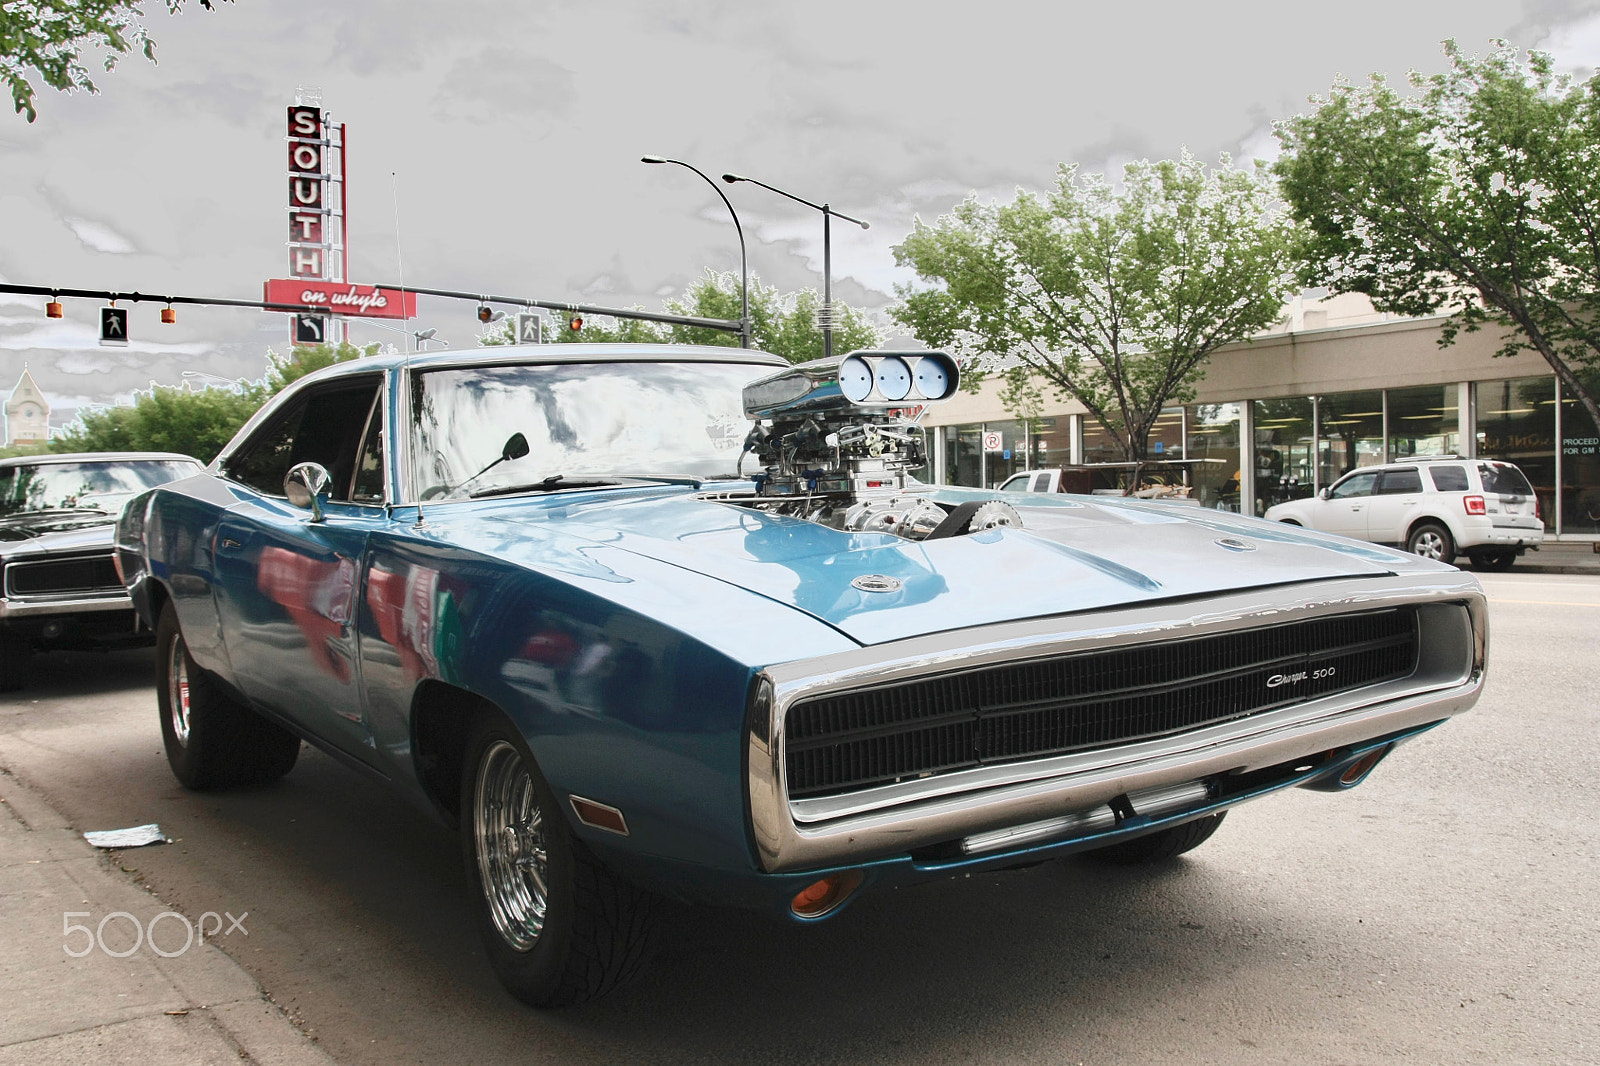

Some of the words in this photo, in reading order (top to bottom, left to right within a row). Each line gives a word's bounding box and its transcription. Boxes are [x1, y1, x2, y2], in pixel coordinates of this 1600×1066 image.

[294, 111, 319, 275] SOUTH
[301, 290, 328, 303] on
[331, 285, 387, 313] whyte
[1562, 437, 1599, 445] PROCEED
[1563, 447, 1579, 455] FOR
[1266, 671, 1308, 688] Charger
[1312, 667, 1336, 679] 500
